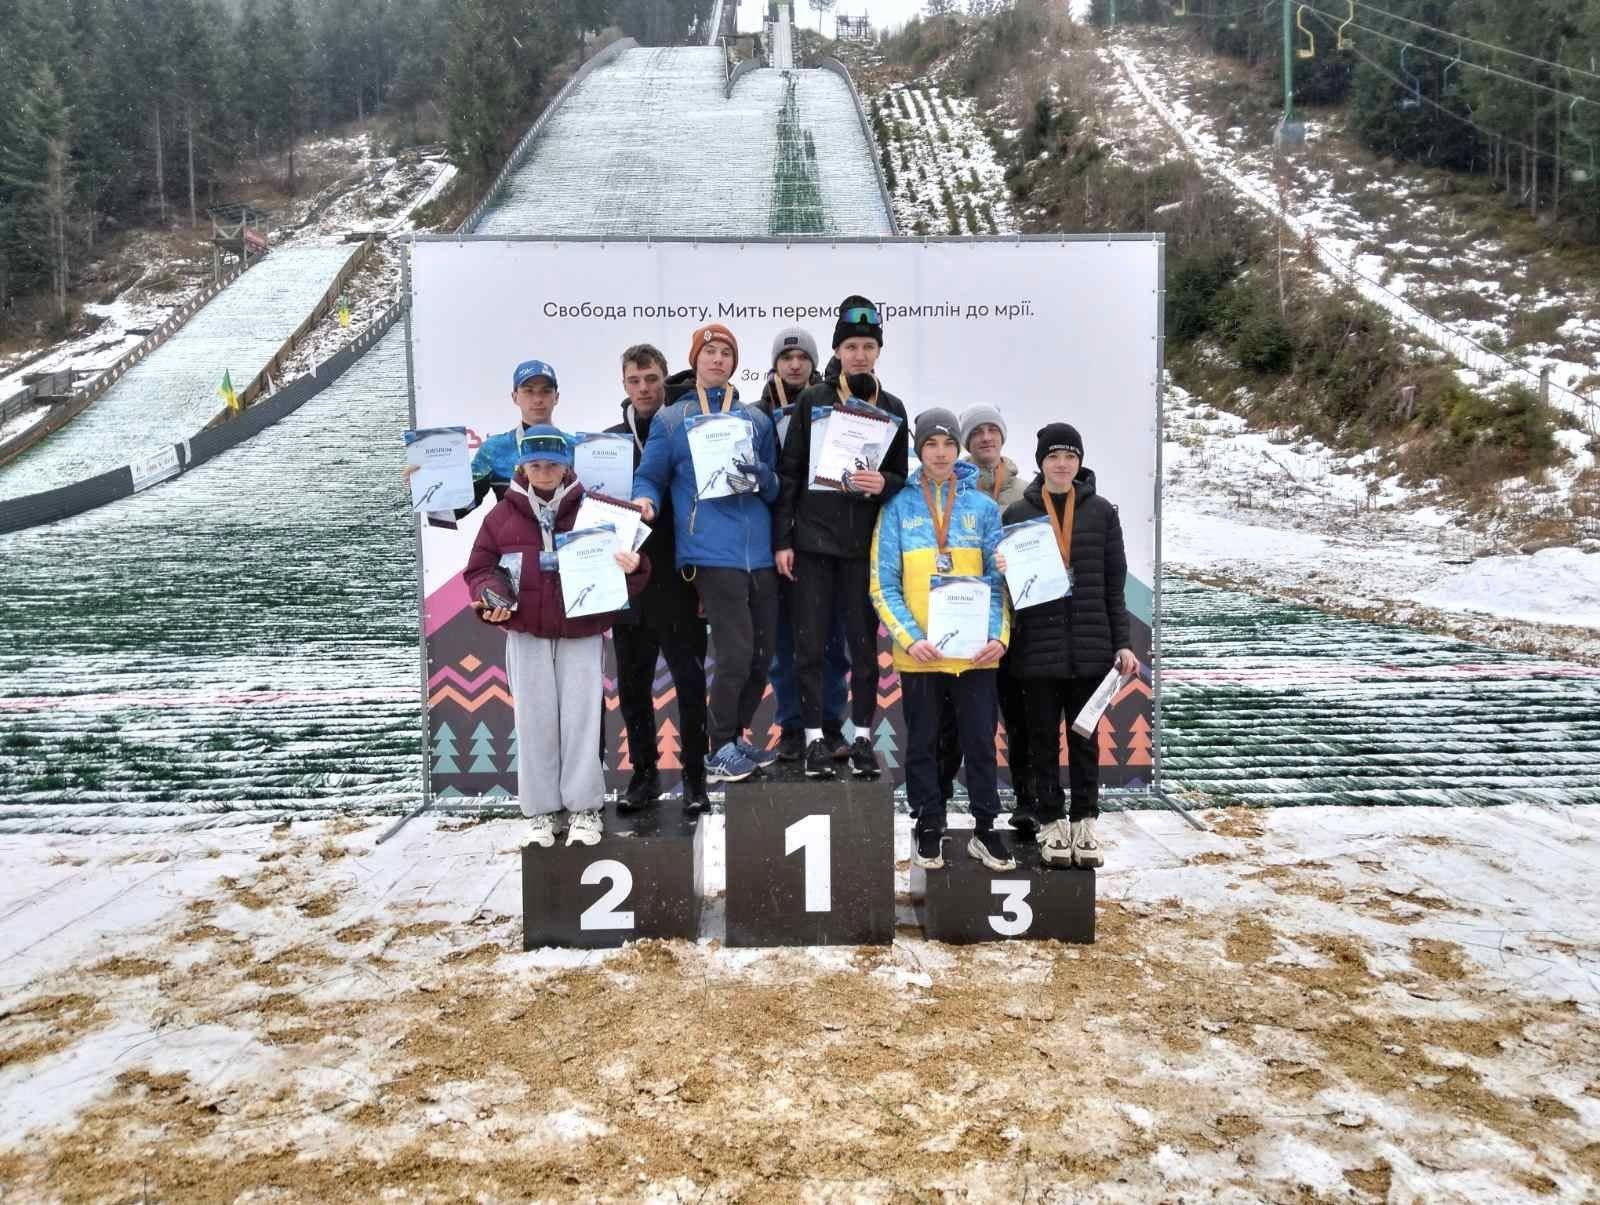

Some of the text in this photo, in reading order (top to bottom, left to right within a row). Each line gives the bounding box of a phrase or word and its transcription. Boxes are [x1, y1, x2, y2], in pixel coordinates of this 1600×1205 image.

[543, 300, 1034, 322] Свобода польоту. Мить перемо Трамплін до мрії.
[741, 369, 760, 381] За
[785, 814, 832, 913] 1
[580, 859, 635, 930] 2
[988, 879, 1034, 936] 3
